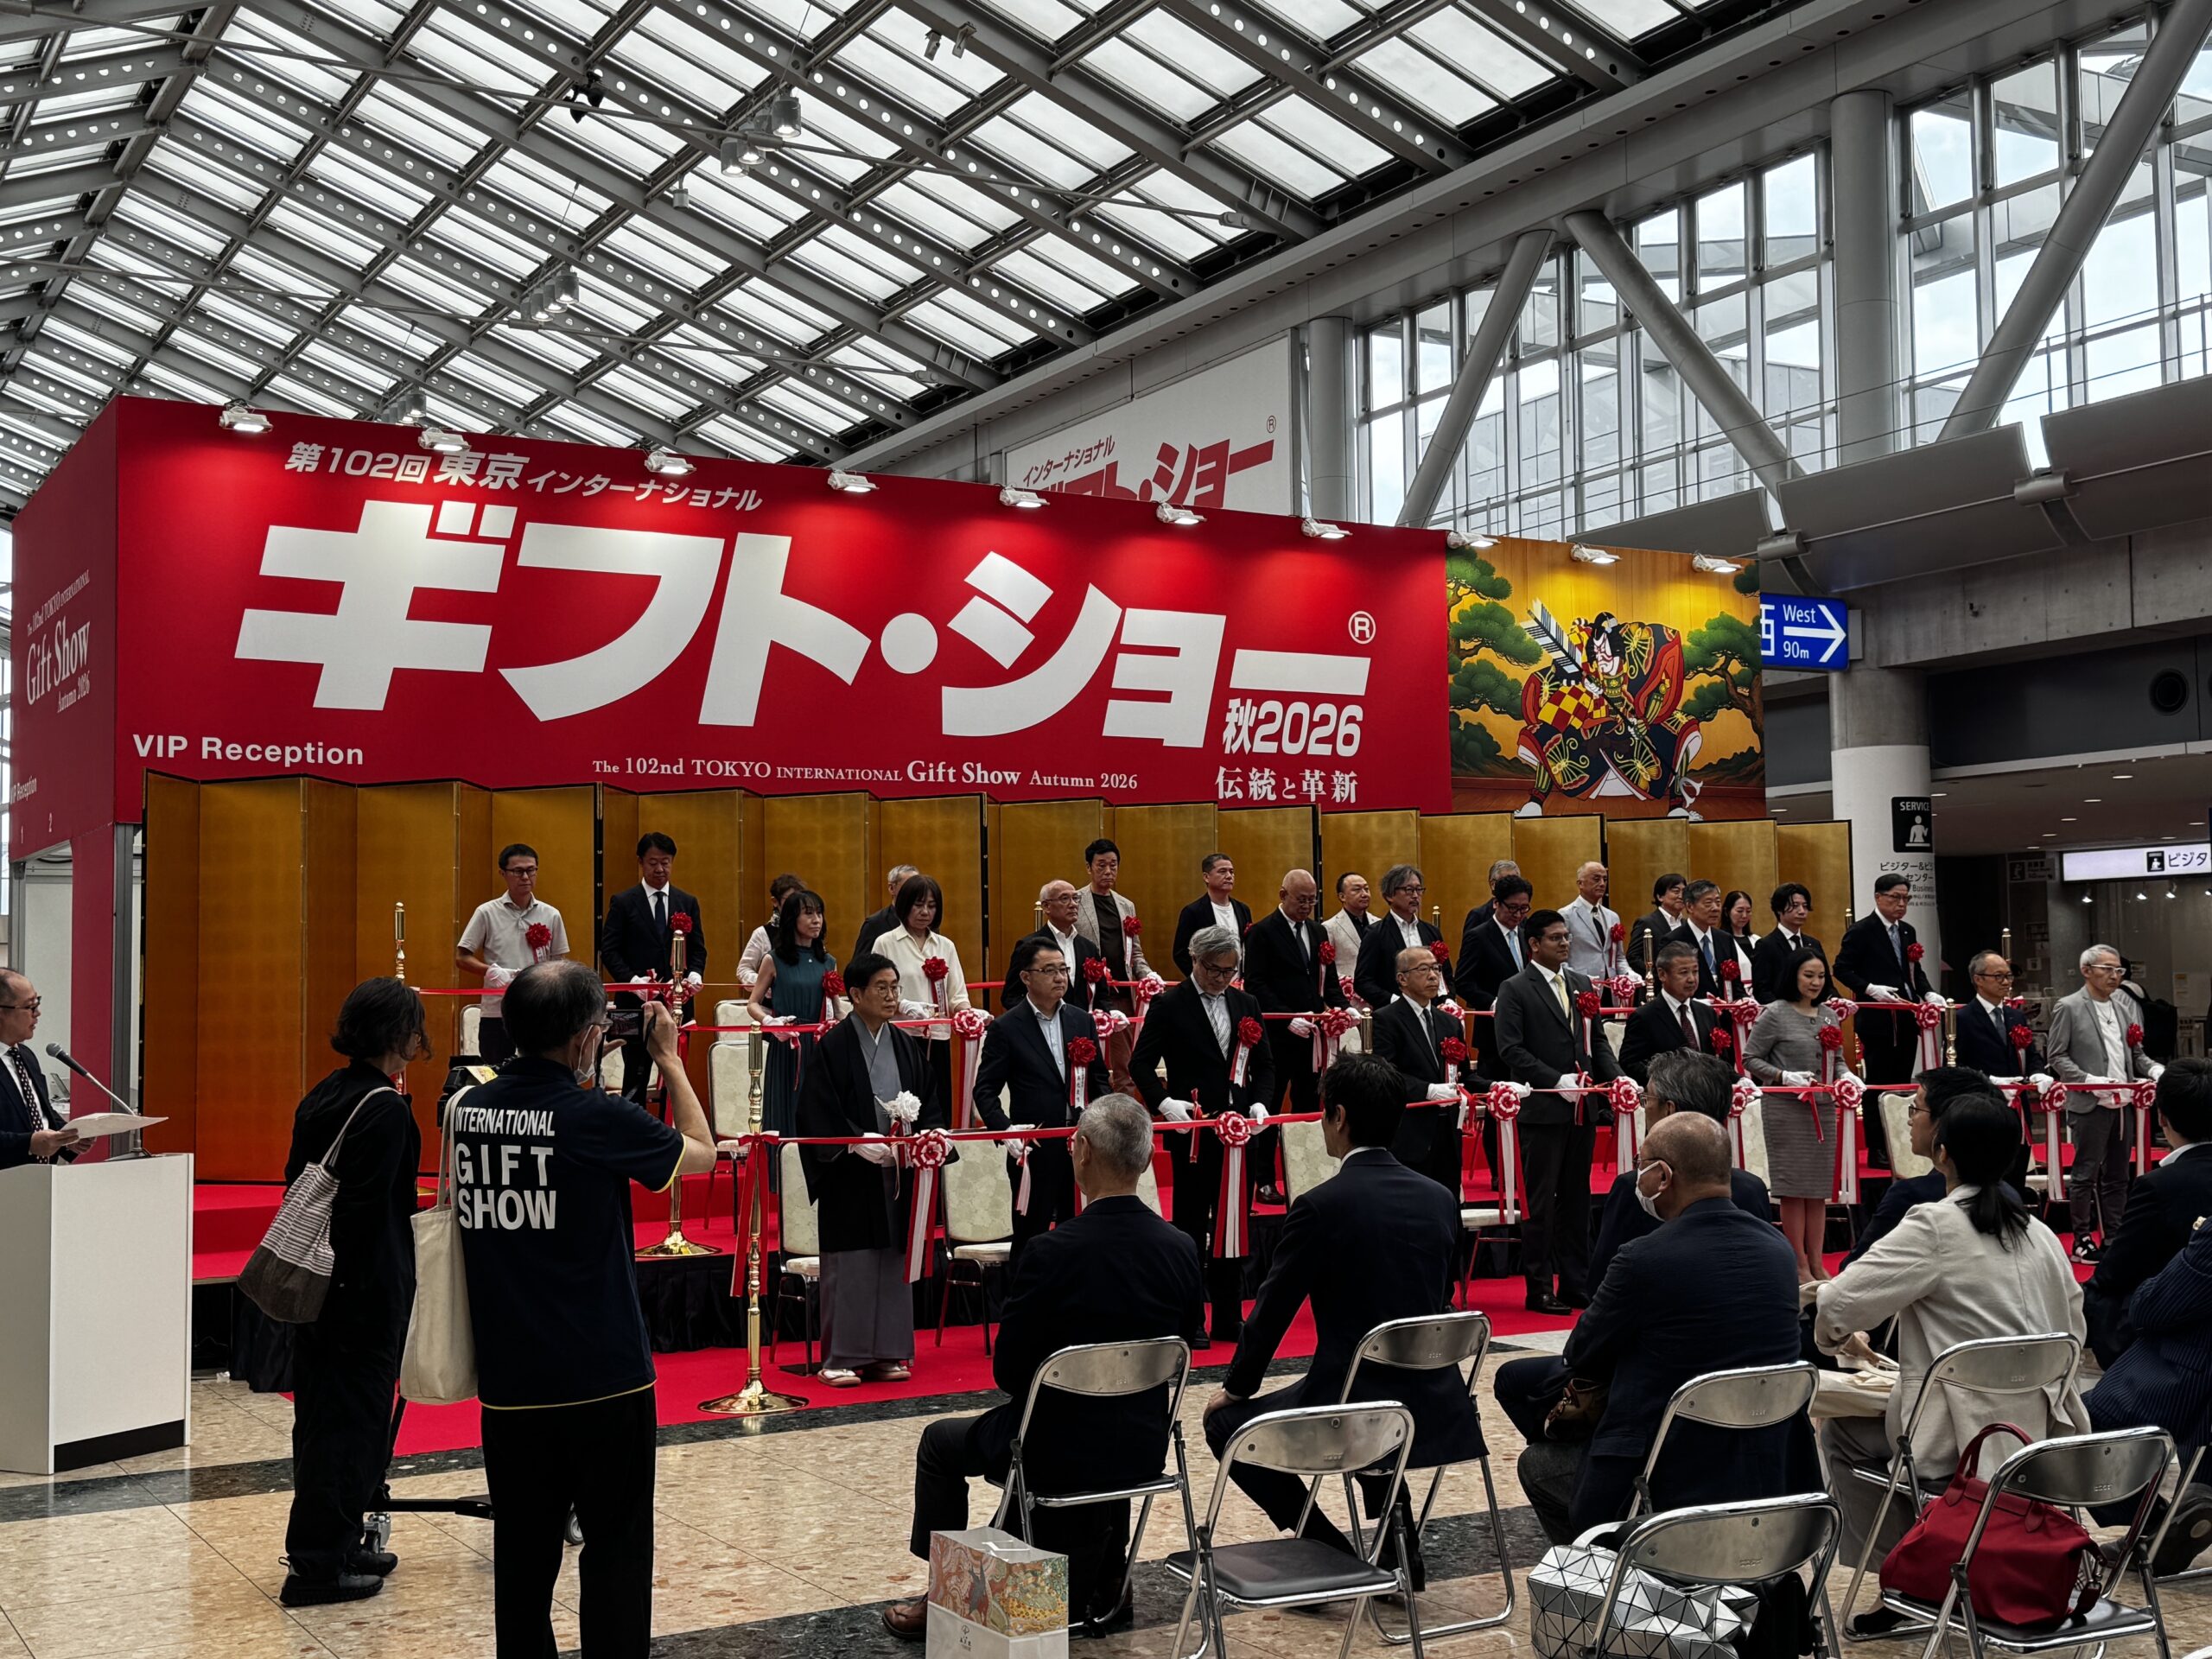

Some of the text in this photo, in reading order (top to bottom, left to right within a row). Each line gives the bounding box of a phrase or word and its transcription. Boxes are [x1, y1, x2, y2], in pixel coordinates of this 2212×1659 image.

[1023, 435, 1116, 487] インターナショナル
[234, 499, 1372, 749] ギフト・ショー
[1783, 603, 1817, 624] West
[27, 614, 91, 706] Gift Show
[1783, 640, 1810, 659] 90m
[1222, 697, 1364, 758] 秋2026
[132, 734, 364, 768] VIP Reception
[592, 757, 1139, 790] The 102nd TOKYO INTERNATIONAL Gift Show Autumn 2026
[1214, 766, 1359, 804] 伝統と革新
[1900, 801, 1931, 811] SERVICE
[2168, 852, 2208, 868] ビジタ
[455, 1142, 554, 1186] GIFT
[458, 1188, 556, 1230] SHOW
